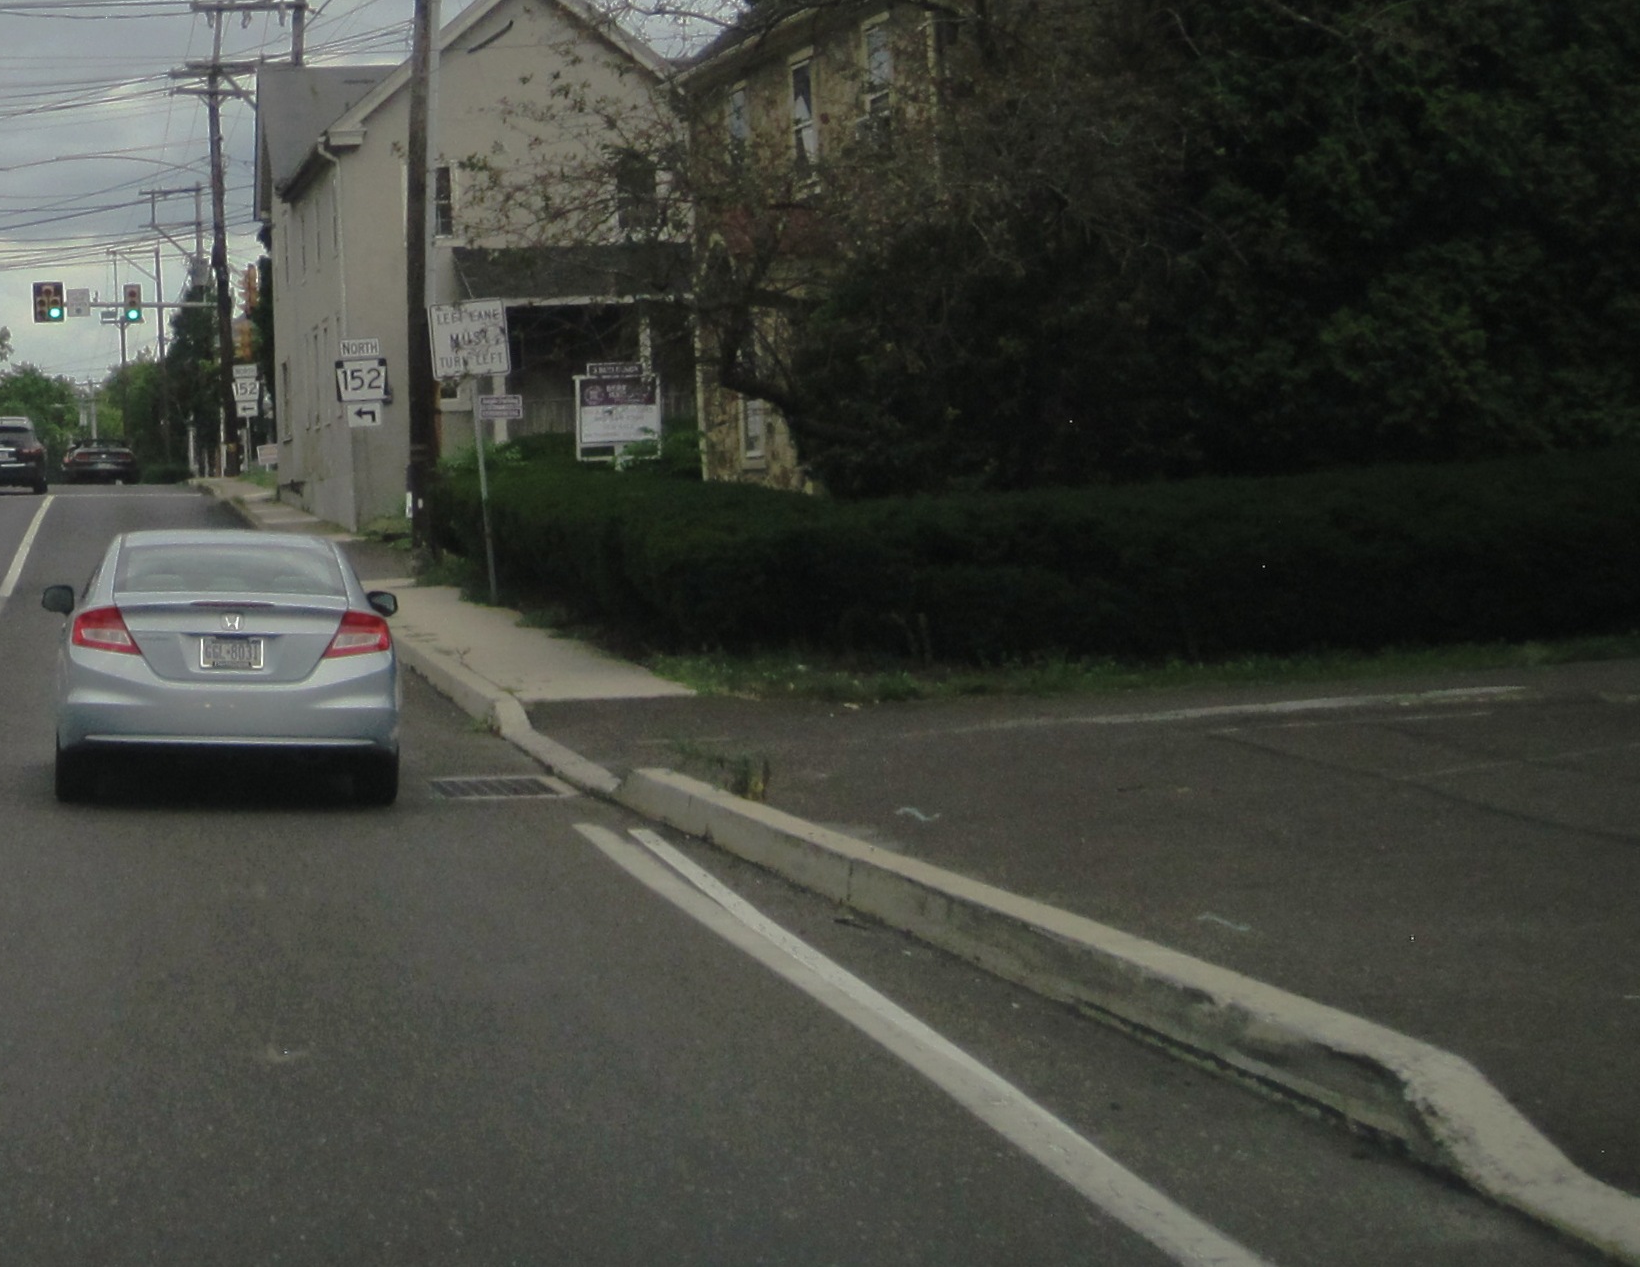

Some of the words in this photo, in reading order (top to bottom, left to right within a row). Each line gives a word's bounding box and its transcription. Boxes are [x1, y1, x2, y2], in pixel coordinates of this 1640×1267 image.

[342, 341, 379, 355] NORTH
[449, 328, 488, 349] MUST
[341, 368, 382, 391] 152
